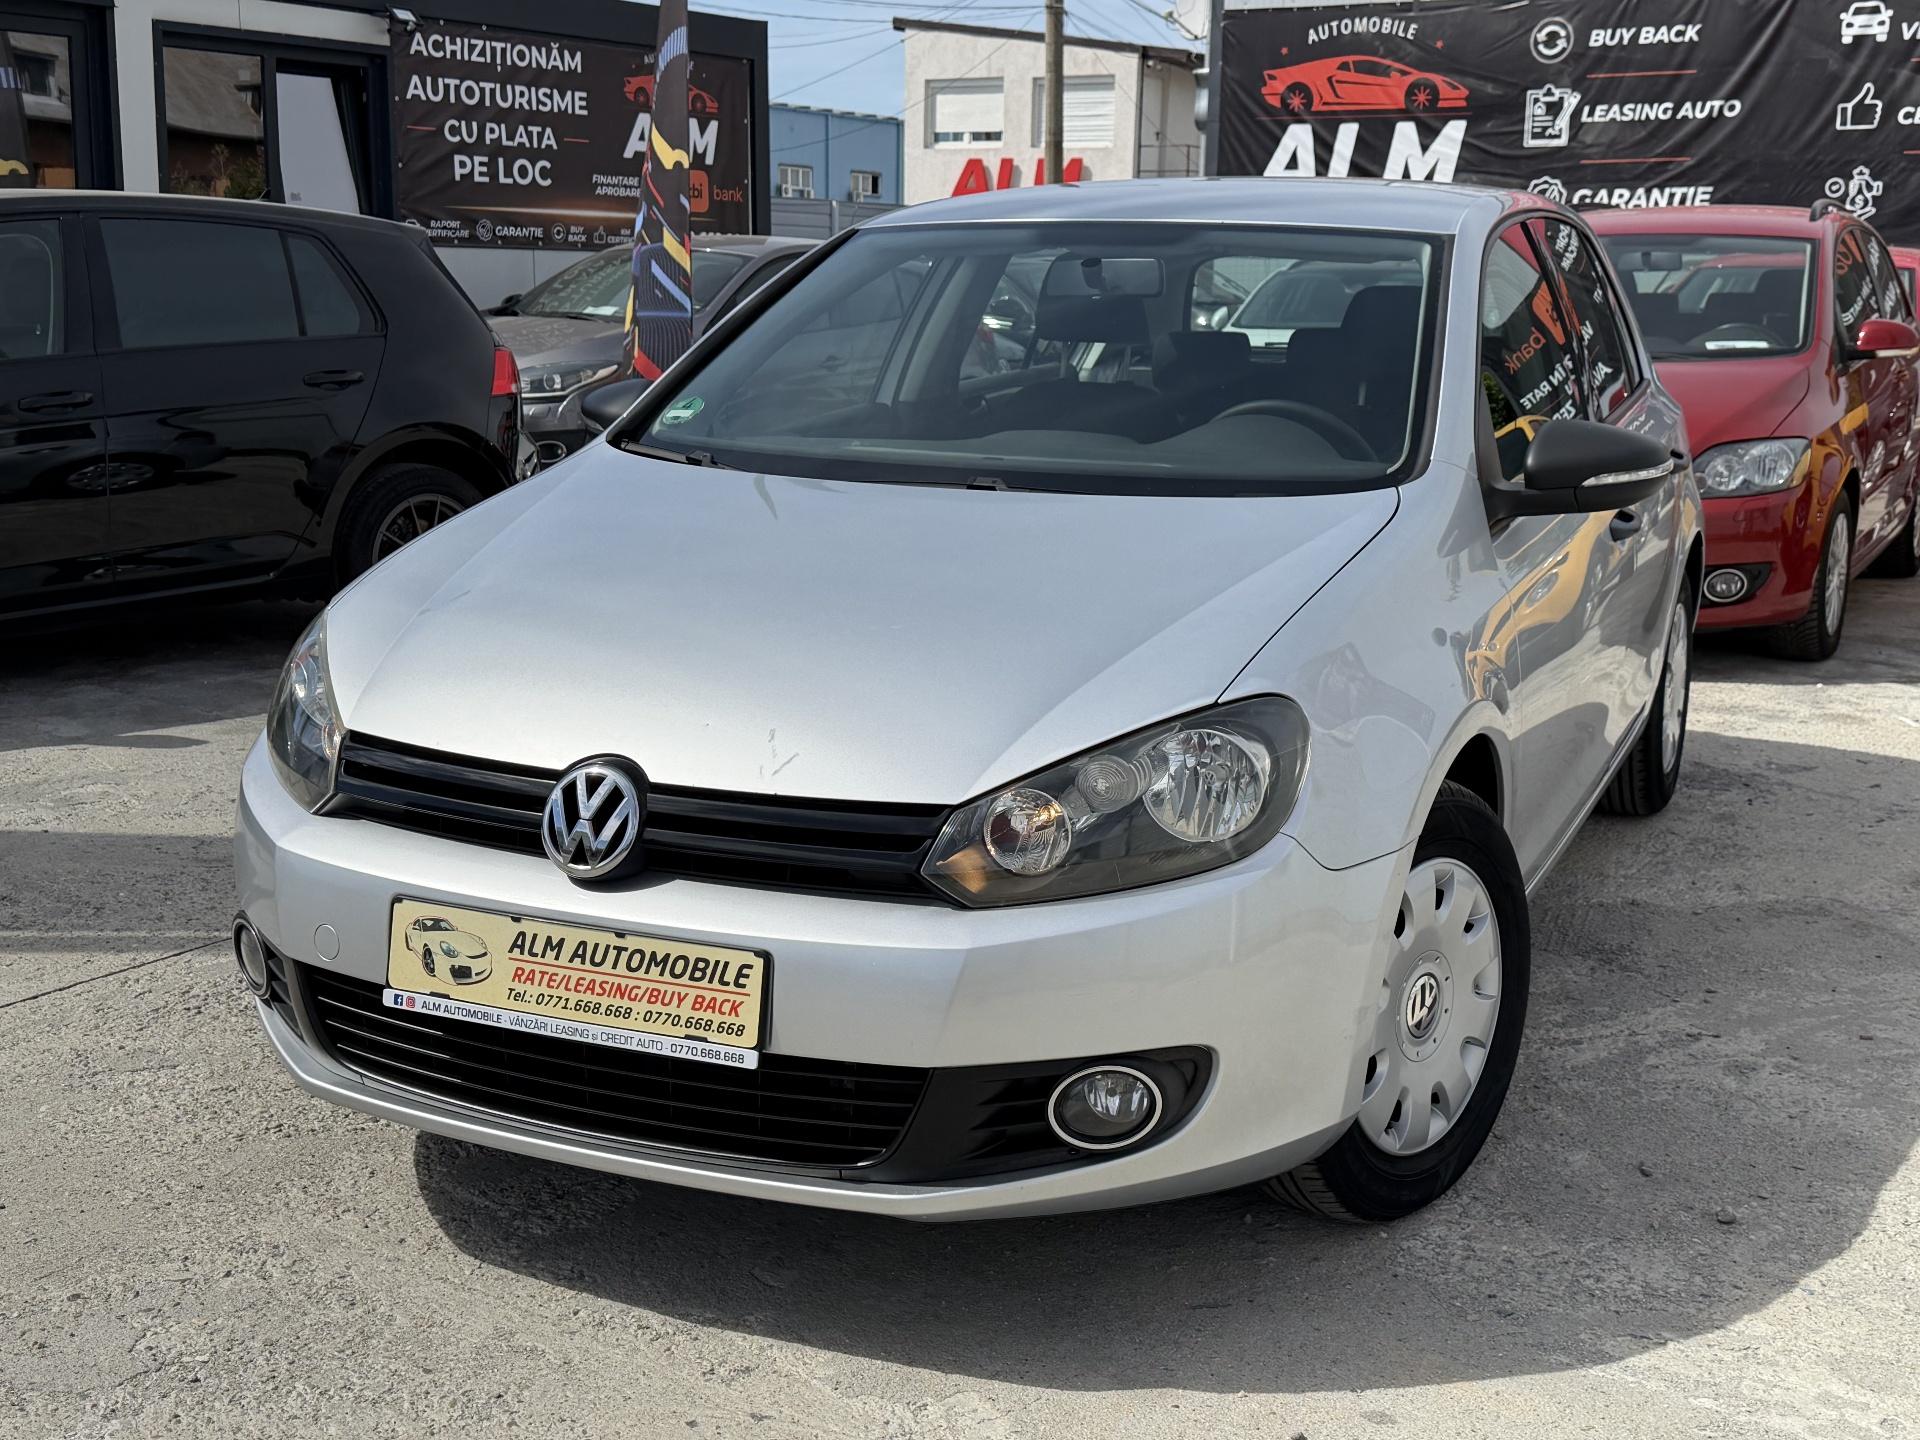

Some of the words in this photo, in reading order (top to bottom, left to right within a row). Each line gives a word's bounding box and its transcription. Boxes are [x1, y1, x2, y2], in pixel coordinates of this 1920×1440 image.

[1307, 16, 1419, 44] AUTOMOBILE
[1588, 27, 1637, 47] BUY
[1638, 23, 1703, 45] BACK
[1901, 21, 1920, 41] V
[409, 32, 582, 73] ACHIZIȚIONĂM
[406, 74, 588, 116] AUTOTURISME
[1580, 102, 1675, 123] LEASING
[1676, 99, 1742, 120] AUTO
[444, 119, 478, 144] CU
[485, 122, 558, 150] PLATA
[623, 112, 719, 166] AM
[453, 154, 490, 183] PE
[498, 157, 552, 187] LOC
[690, 183, 703, 199] bi
[713, 184, 743, 203] bank
[430, 220, 461, 229] RAPORT
[567, 234, 587, 242] BACK
[570, 225, 585, 234] BUY
[508, 930, 566, 961] ALM
[568, 940, 754, 989] AUTOMOBILE
[511, 966, 690, 1009] RATE/LEASING/BUY
[691, 994, 745, 1017] BACK
[506, 988, 534, 1004] Tel.:
[535, 992, 633, 1019] 0771.668.668
[643, 1009, 746, 1037] 0770.668.668
[421, 1000, 441, 1013] ALM
[443, 1006, 503, 1024] AUTOMOBILE
[509, 1014, 548, 1032] VÂNZĂRI
[550, 1023, 589, 1039] LEASING
[600, 1032, 634, 1047] CREDIT
[636, 1039, 663, 1051] AUTO
[670, 1043, 745, 1064] 0770.668.668
